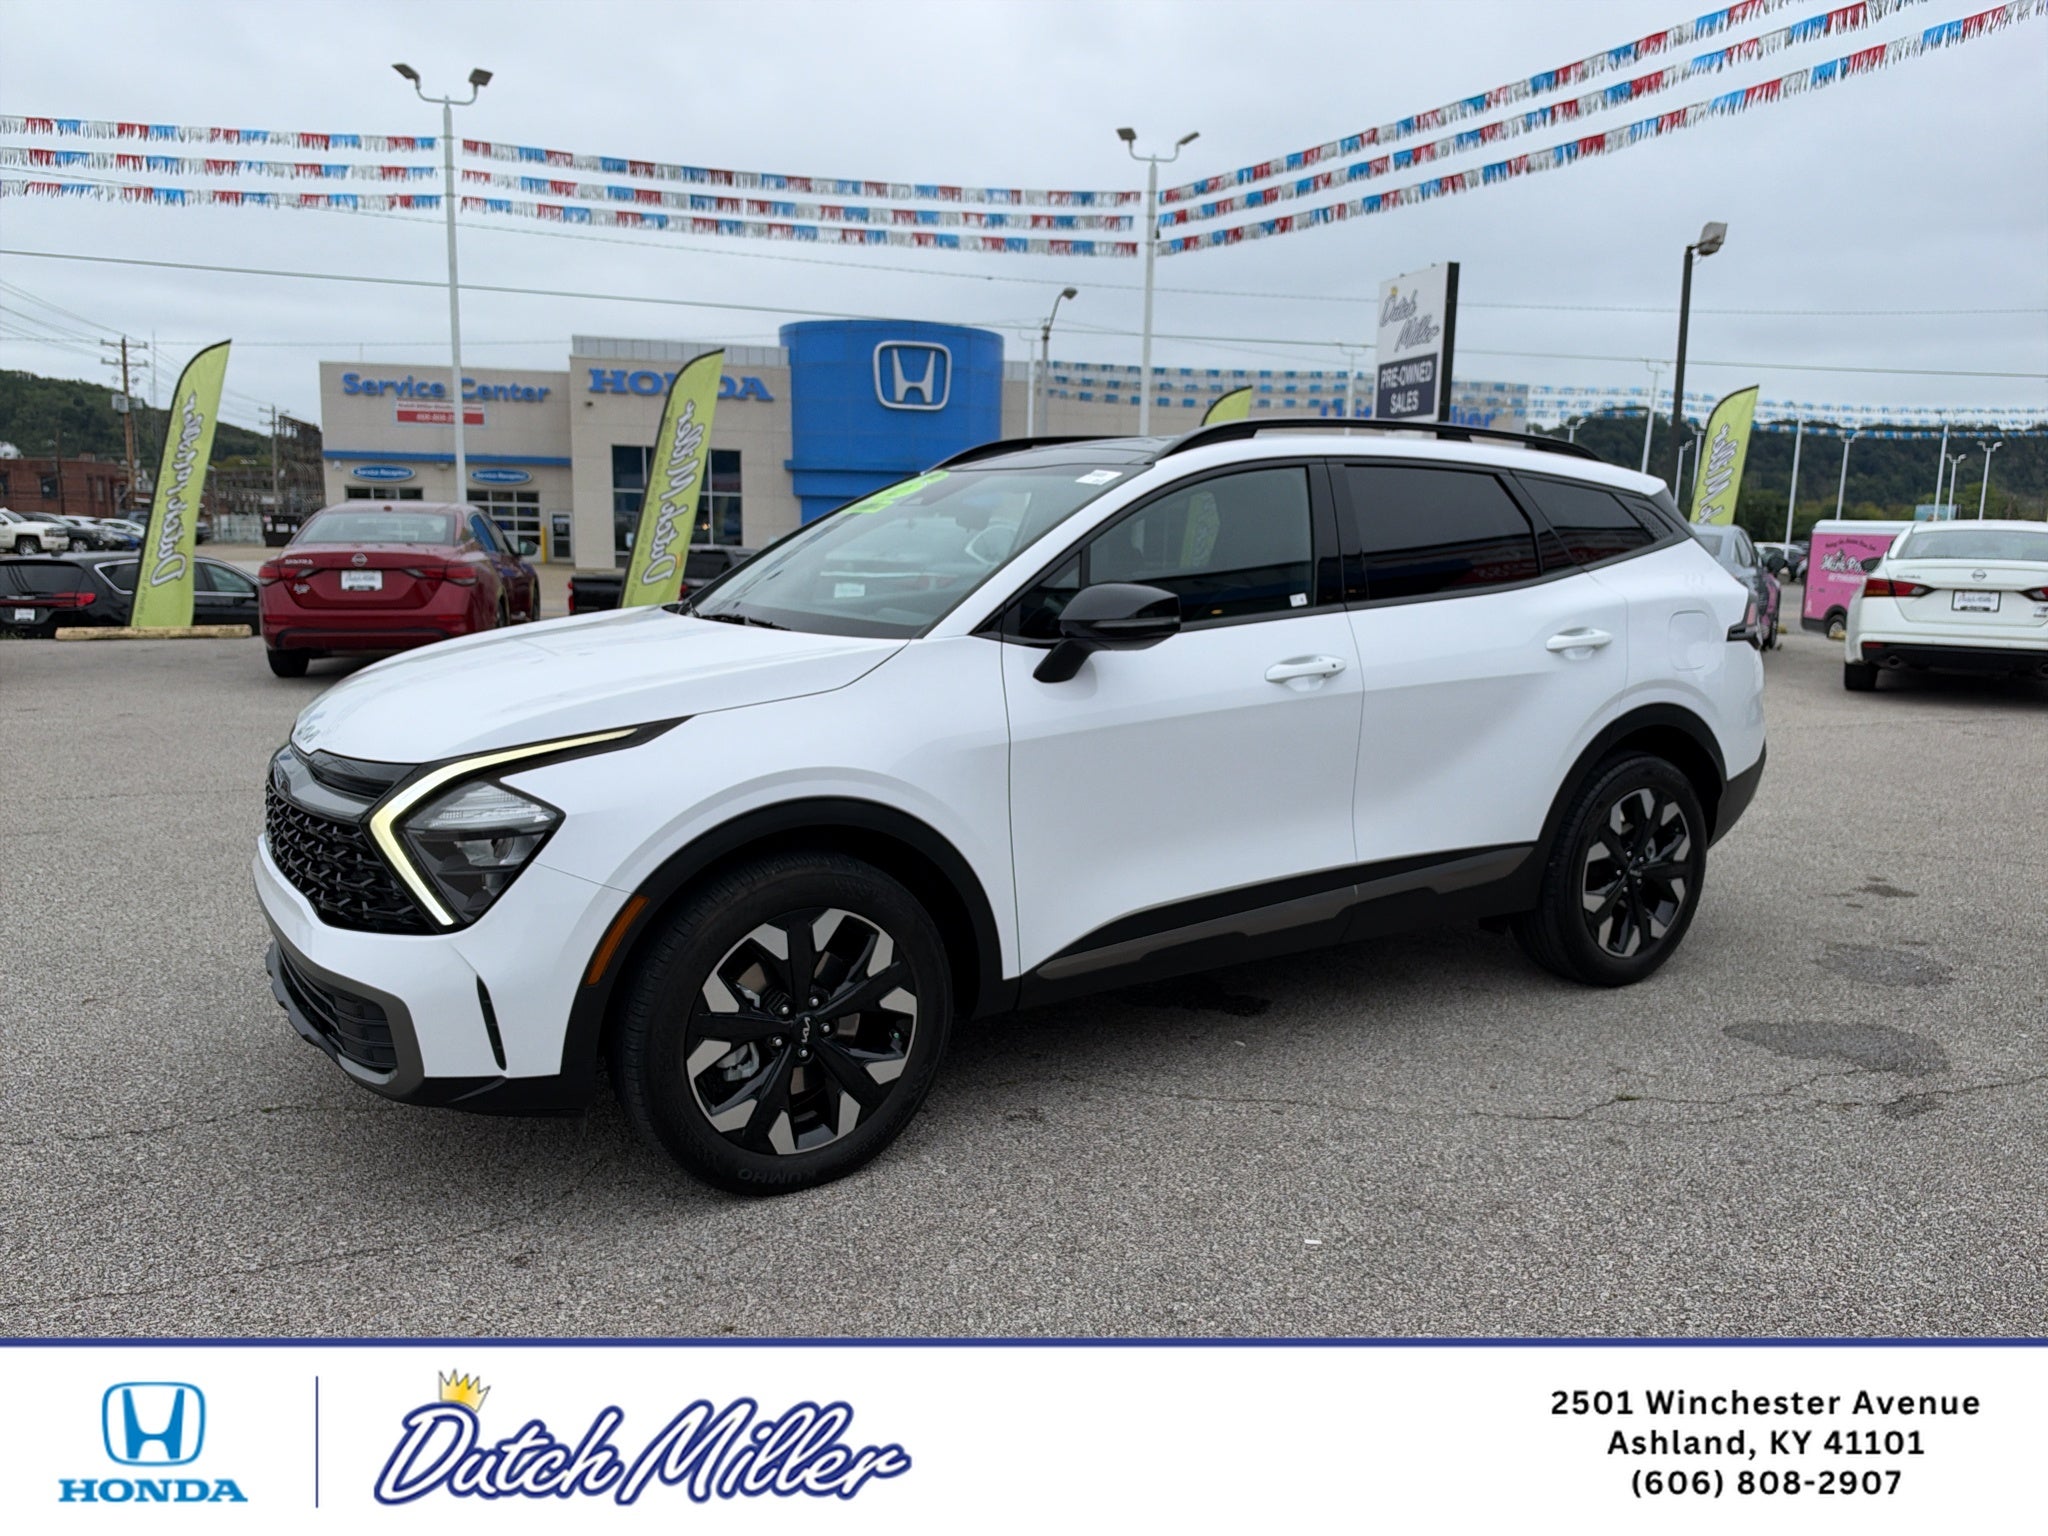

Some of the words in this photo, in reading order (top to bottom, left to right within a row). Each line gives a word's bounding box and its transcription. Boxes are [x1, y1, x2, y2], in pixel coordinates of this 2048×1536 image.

[342, 372, 446, 398] Service
[461, 377, 551, 402] Center
[1380, 360, 1433, 389] PRE-OWNED
[1389, 390, 1419, 414] SALES
